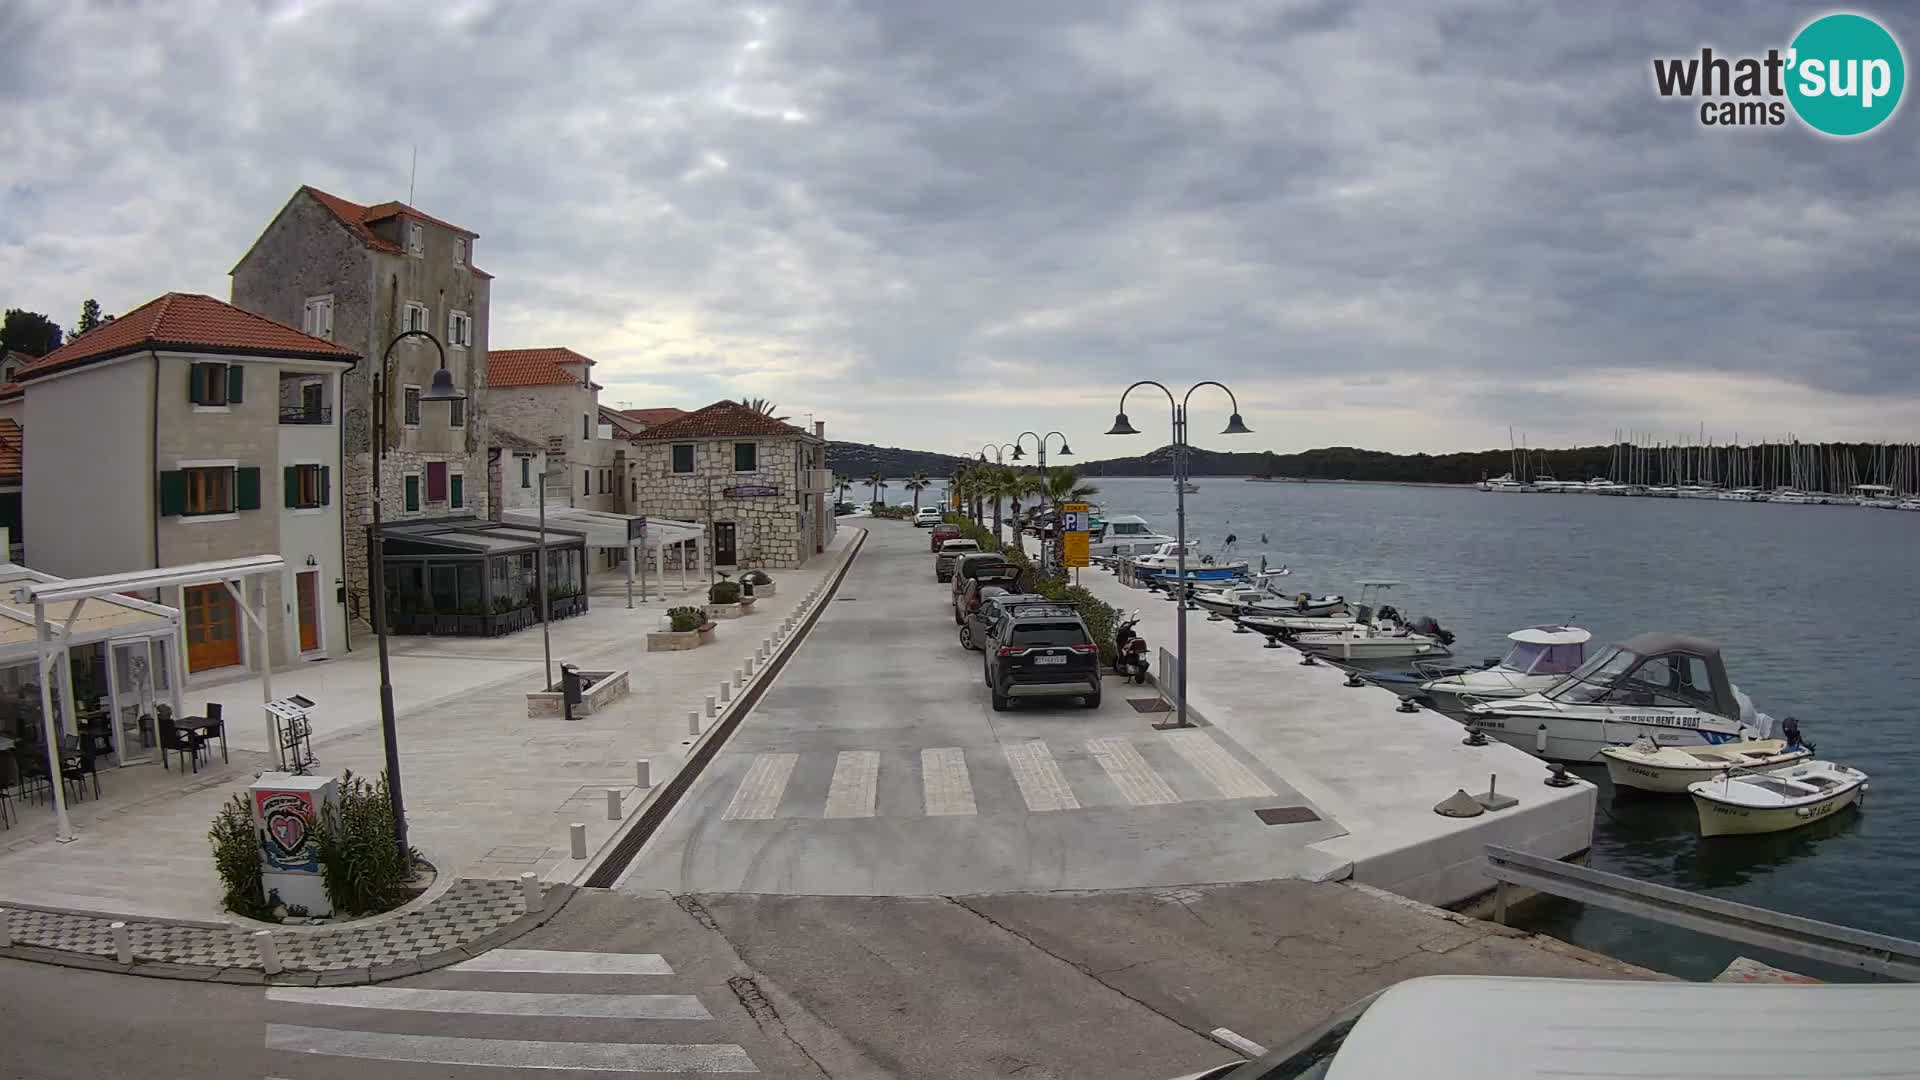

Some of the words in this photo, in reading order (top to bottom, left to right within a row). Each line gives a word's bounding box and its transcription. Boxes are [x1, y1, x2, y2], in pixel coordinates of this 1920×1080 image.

[1066, 513, 1076, 529] P
[1655, 716, 1675, 726] RENT
[1676, 716, 1681, 726] A
[1683, 717, 1700, 728] BOAT
